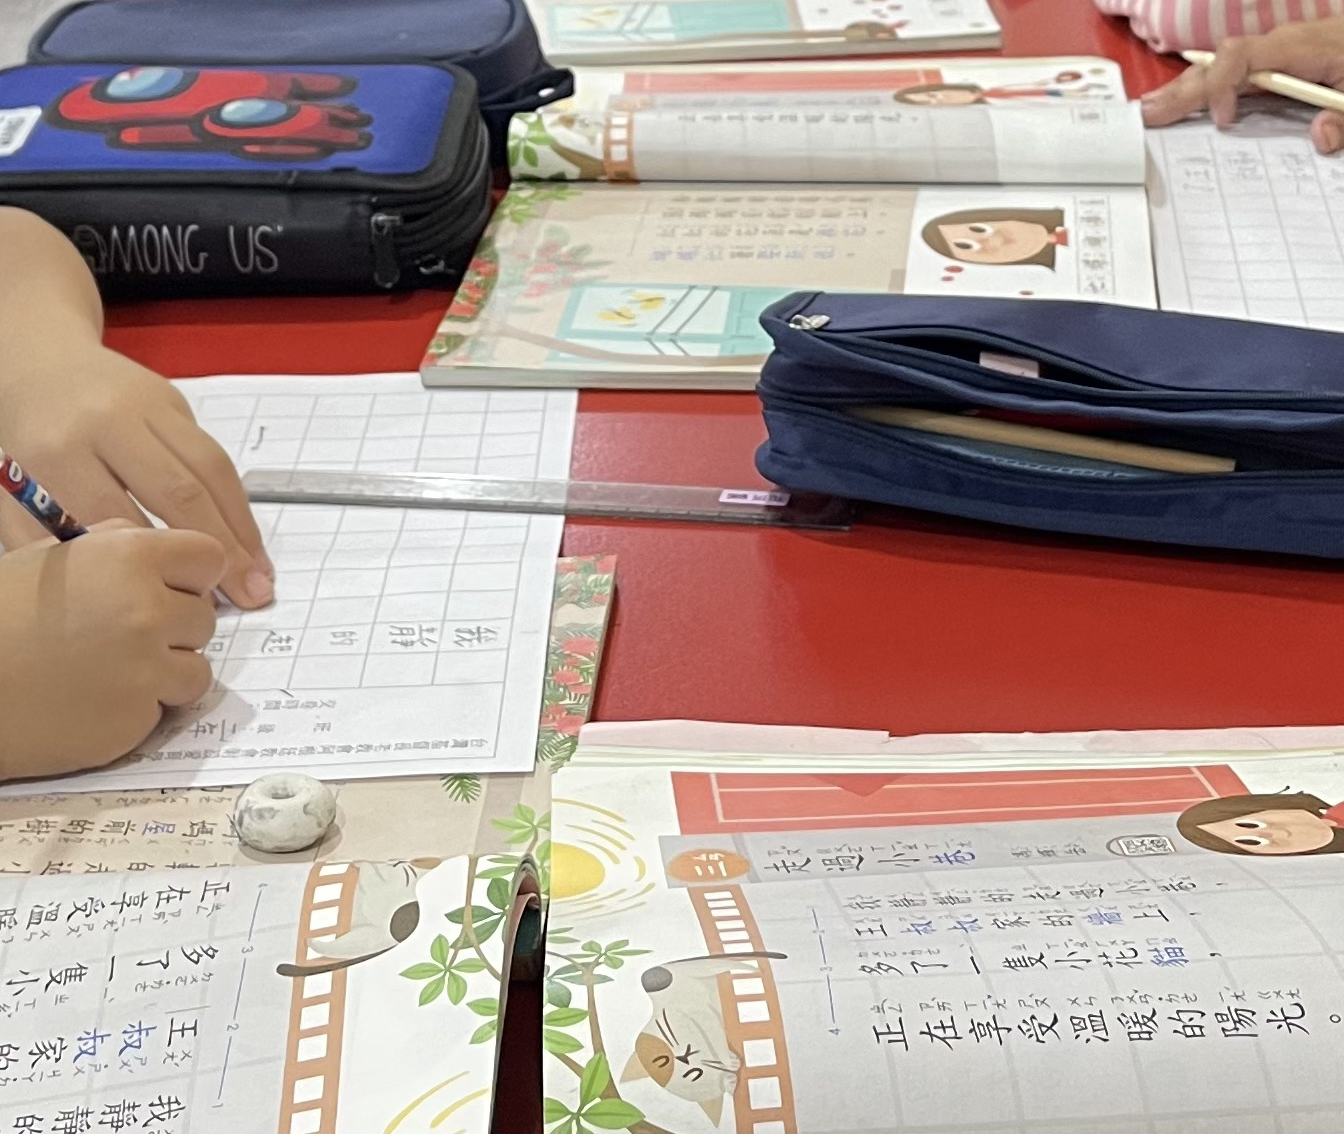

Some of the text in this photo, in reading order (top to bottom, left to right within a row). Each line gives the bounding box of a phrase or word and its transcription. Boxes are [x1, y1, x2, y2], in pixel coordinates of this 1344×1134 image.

[229, 225, 279, 274] US
[764, 849, 976, 874] 走過小巷
[872, 1002, 1342, 1051] 正在享受溫暖的陽光。
